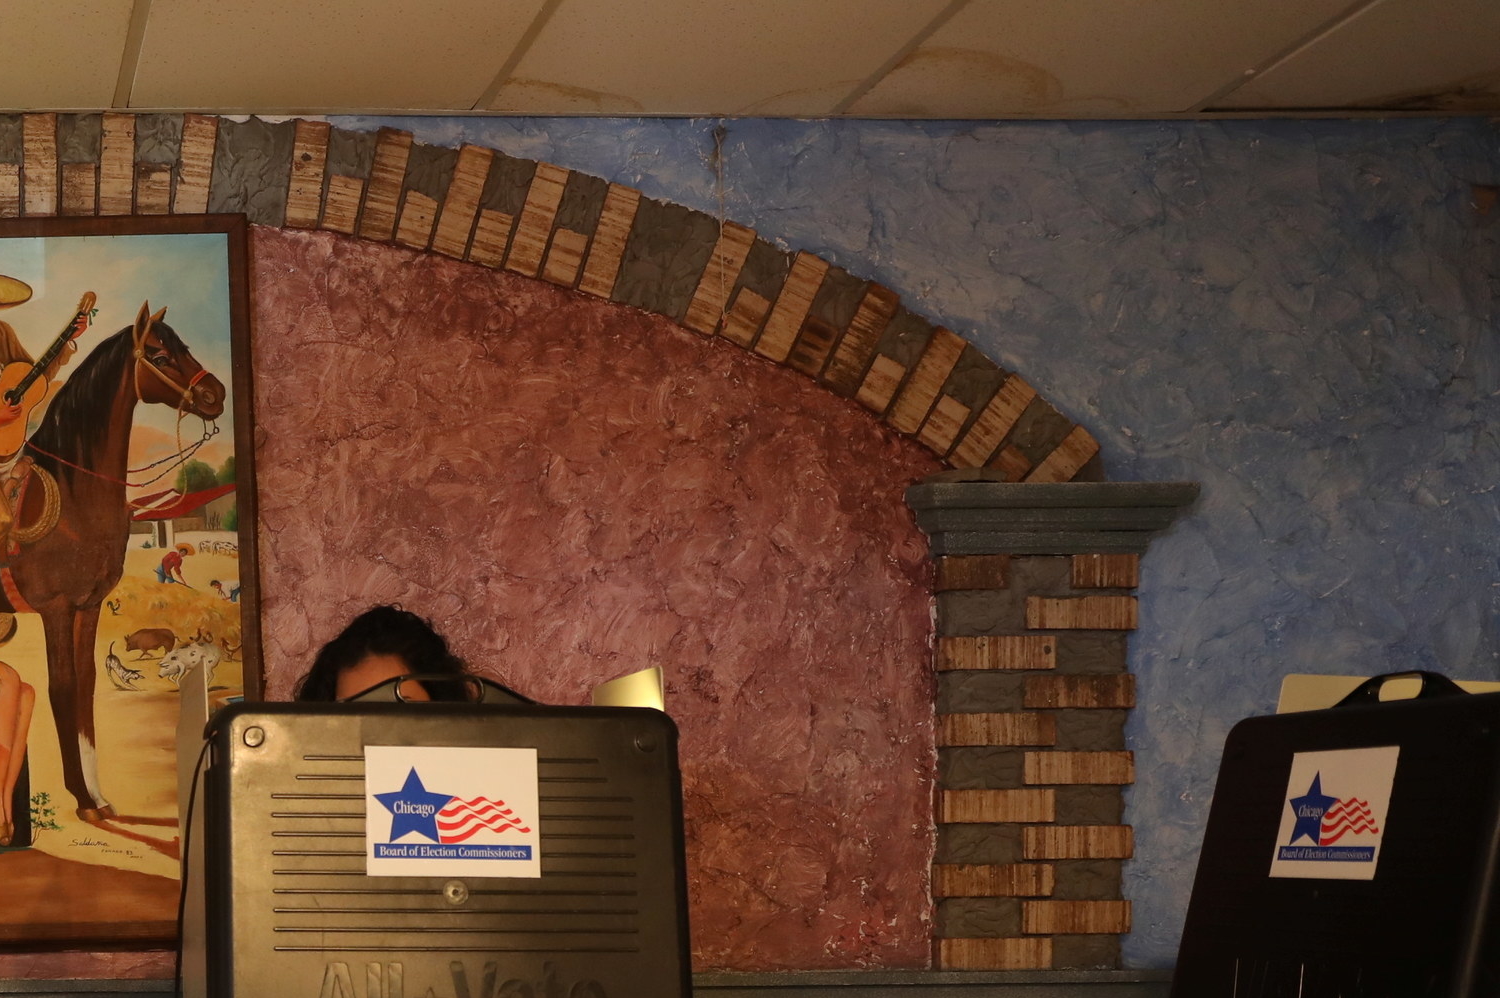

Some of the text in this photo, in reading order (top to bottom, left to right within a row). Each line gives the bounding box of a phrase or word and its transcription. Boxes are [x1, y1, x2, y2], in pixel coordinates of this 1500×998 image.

[393, 800, 435, 818] Chicago
[1298, 804, 1323, 819] Chicago
[379, 846, 527, 858] Board of Election Commissioners
[1280, 848, 1371, 860] Board of Election Commissioners
